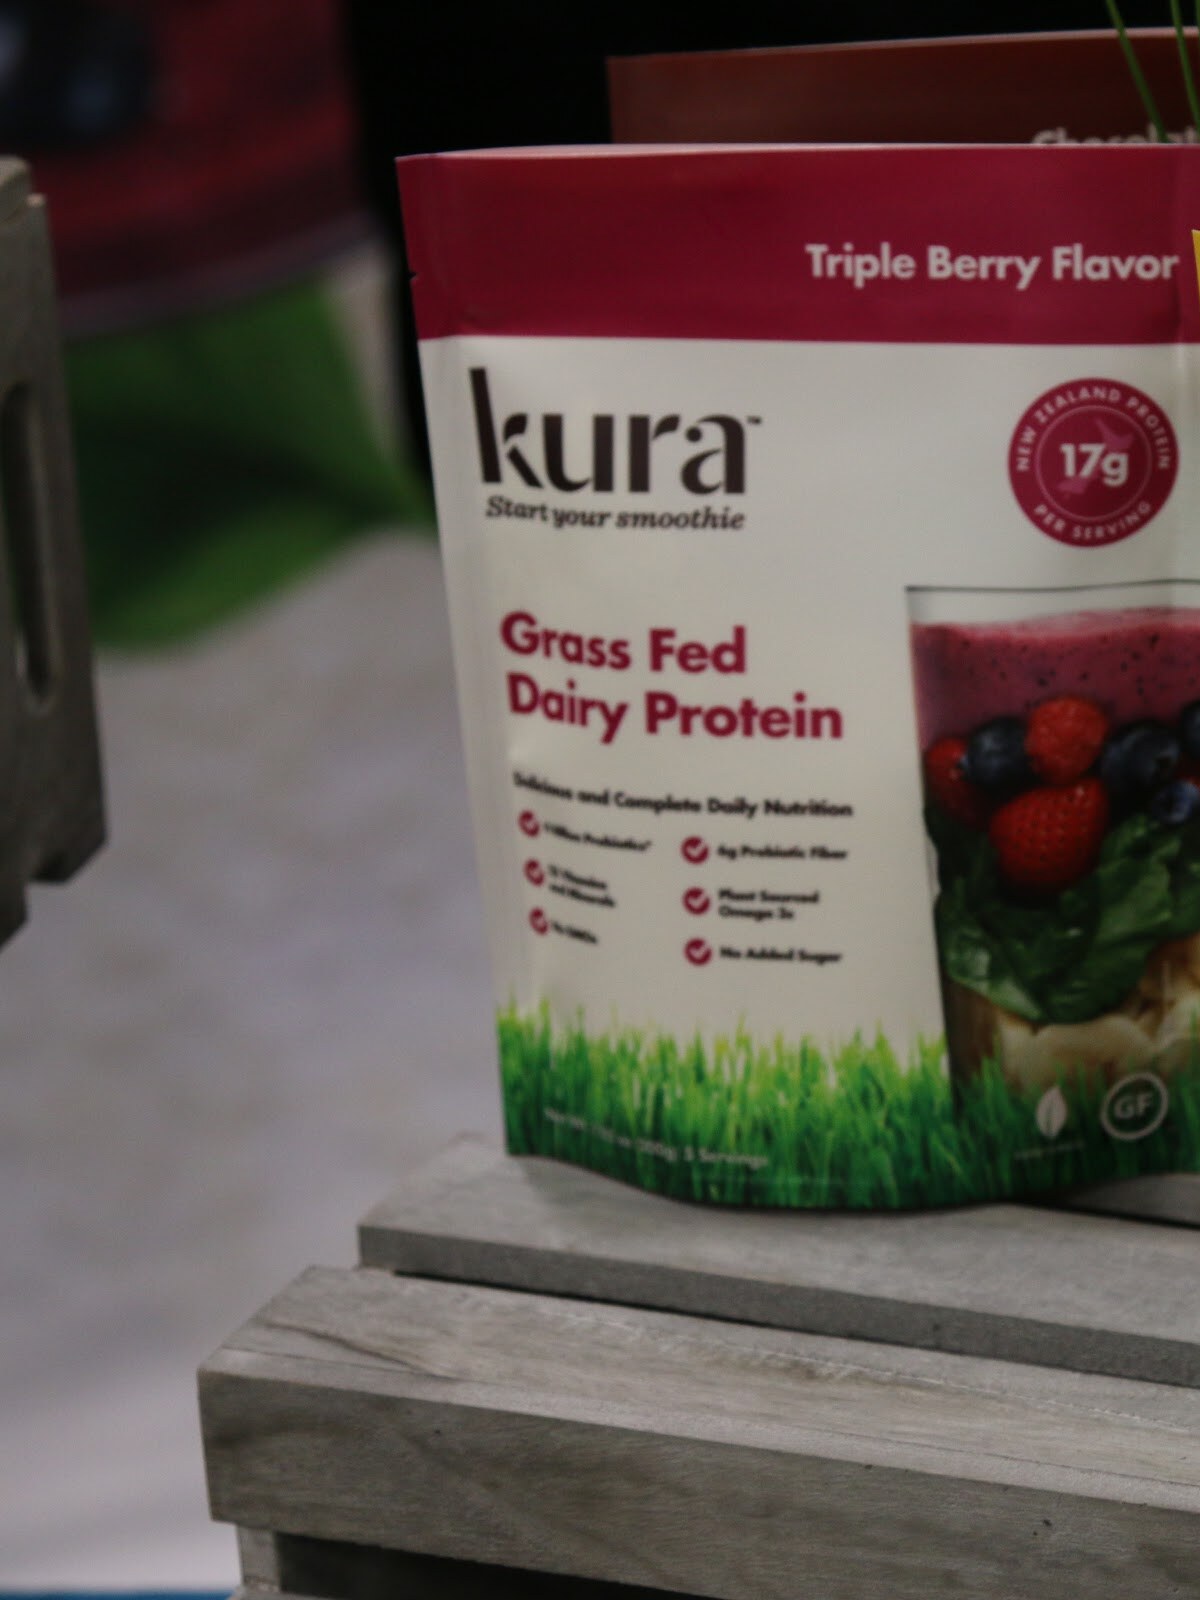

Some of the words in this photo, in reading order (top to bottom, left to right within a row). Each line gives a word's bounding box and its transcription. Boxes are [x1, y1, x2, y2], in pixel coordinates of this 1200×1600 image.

[805, 242, 916, 289] Triple
[928, 245, 1041, 290] Berry
[1052, 243, 1179, 280] Flavor
[1016, 426, 1037, 472] NEW
[1034, 386, 1121, 423] ZEALAND
[1126, 397, 1171, 469] PROTEIN
[1060, 443, 1129, 488] 17g
[486, 495, 548, 520] Start
[553, 505, 610, 529] your
[615, 505, 745, 530] smoothie
[1034, 504, 1066, 532] PER
[1073, 501, 1150, 539] SERVING
[500, 611, 632, 671] Grass
[649, 624, 746, 674] Fed
[507, 671, 629, 745] Dairy
[645, 691, 843, 739] Protein
[577, 788, 609, 805] and
[614, 791, 701, 815] Complete
[707, 796, 758, 819] Daily
[764, 798, 853, 816] Nutrition
[1114, 1093, 1152, 1119] GF
